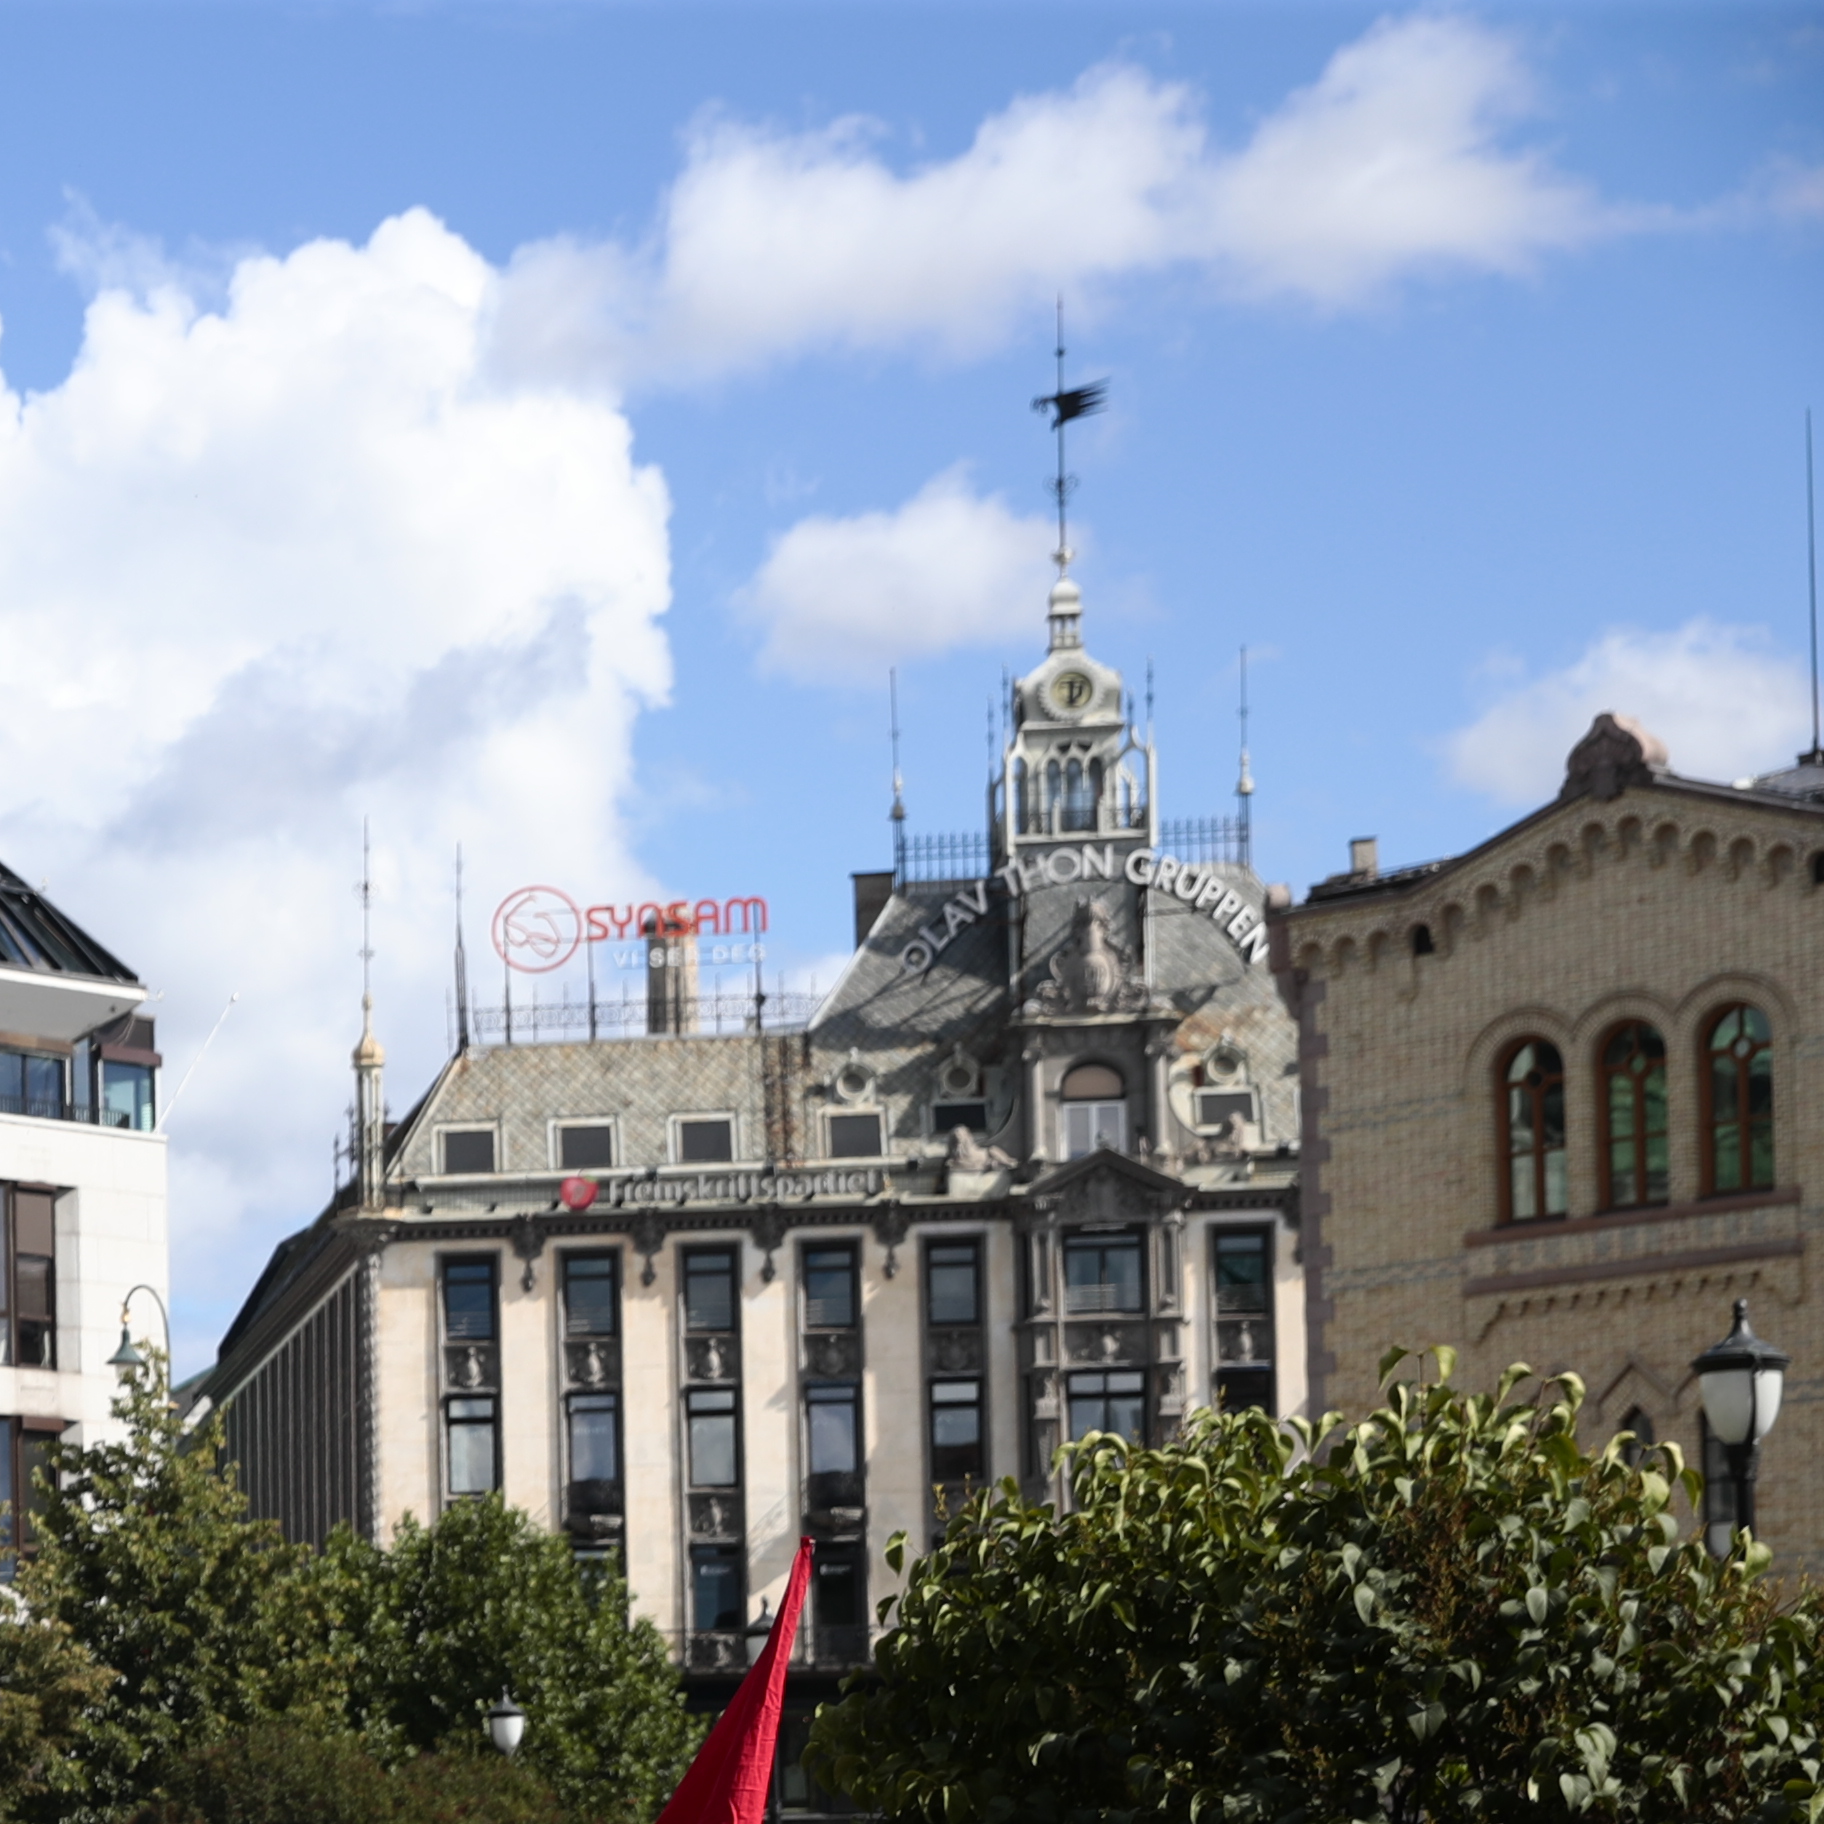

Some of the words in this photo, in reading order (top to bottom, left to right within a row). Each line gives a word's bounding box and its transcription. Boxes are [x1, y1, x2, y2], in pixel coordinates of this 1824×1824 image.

[585, 895, 770, 942] SYNSAM
[901, 879, 989, 975] OLAV
[995, 843, 1114, 898] THON
[1125, 847, 1271, 965] GRUPPEN
[608, 1169, 879, 1205] Fremskrittspartiet
